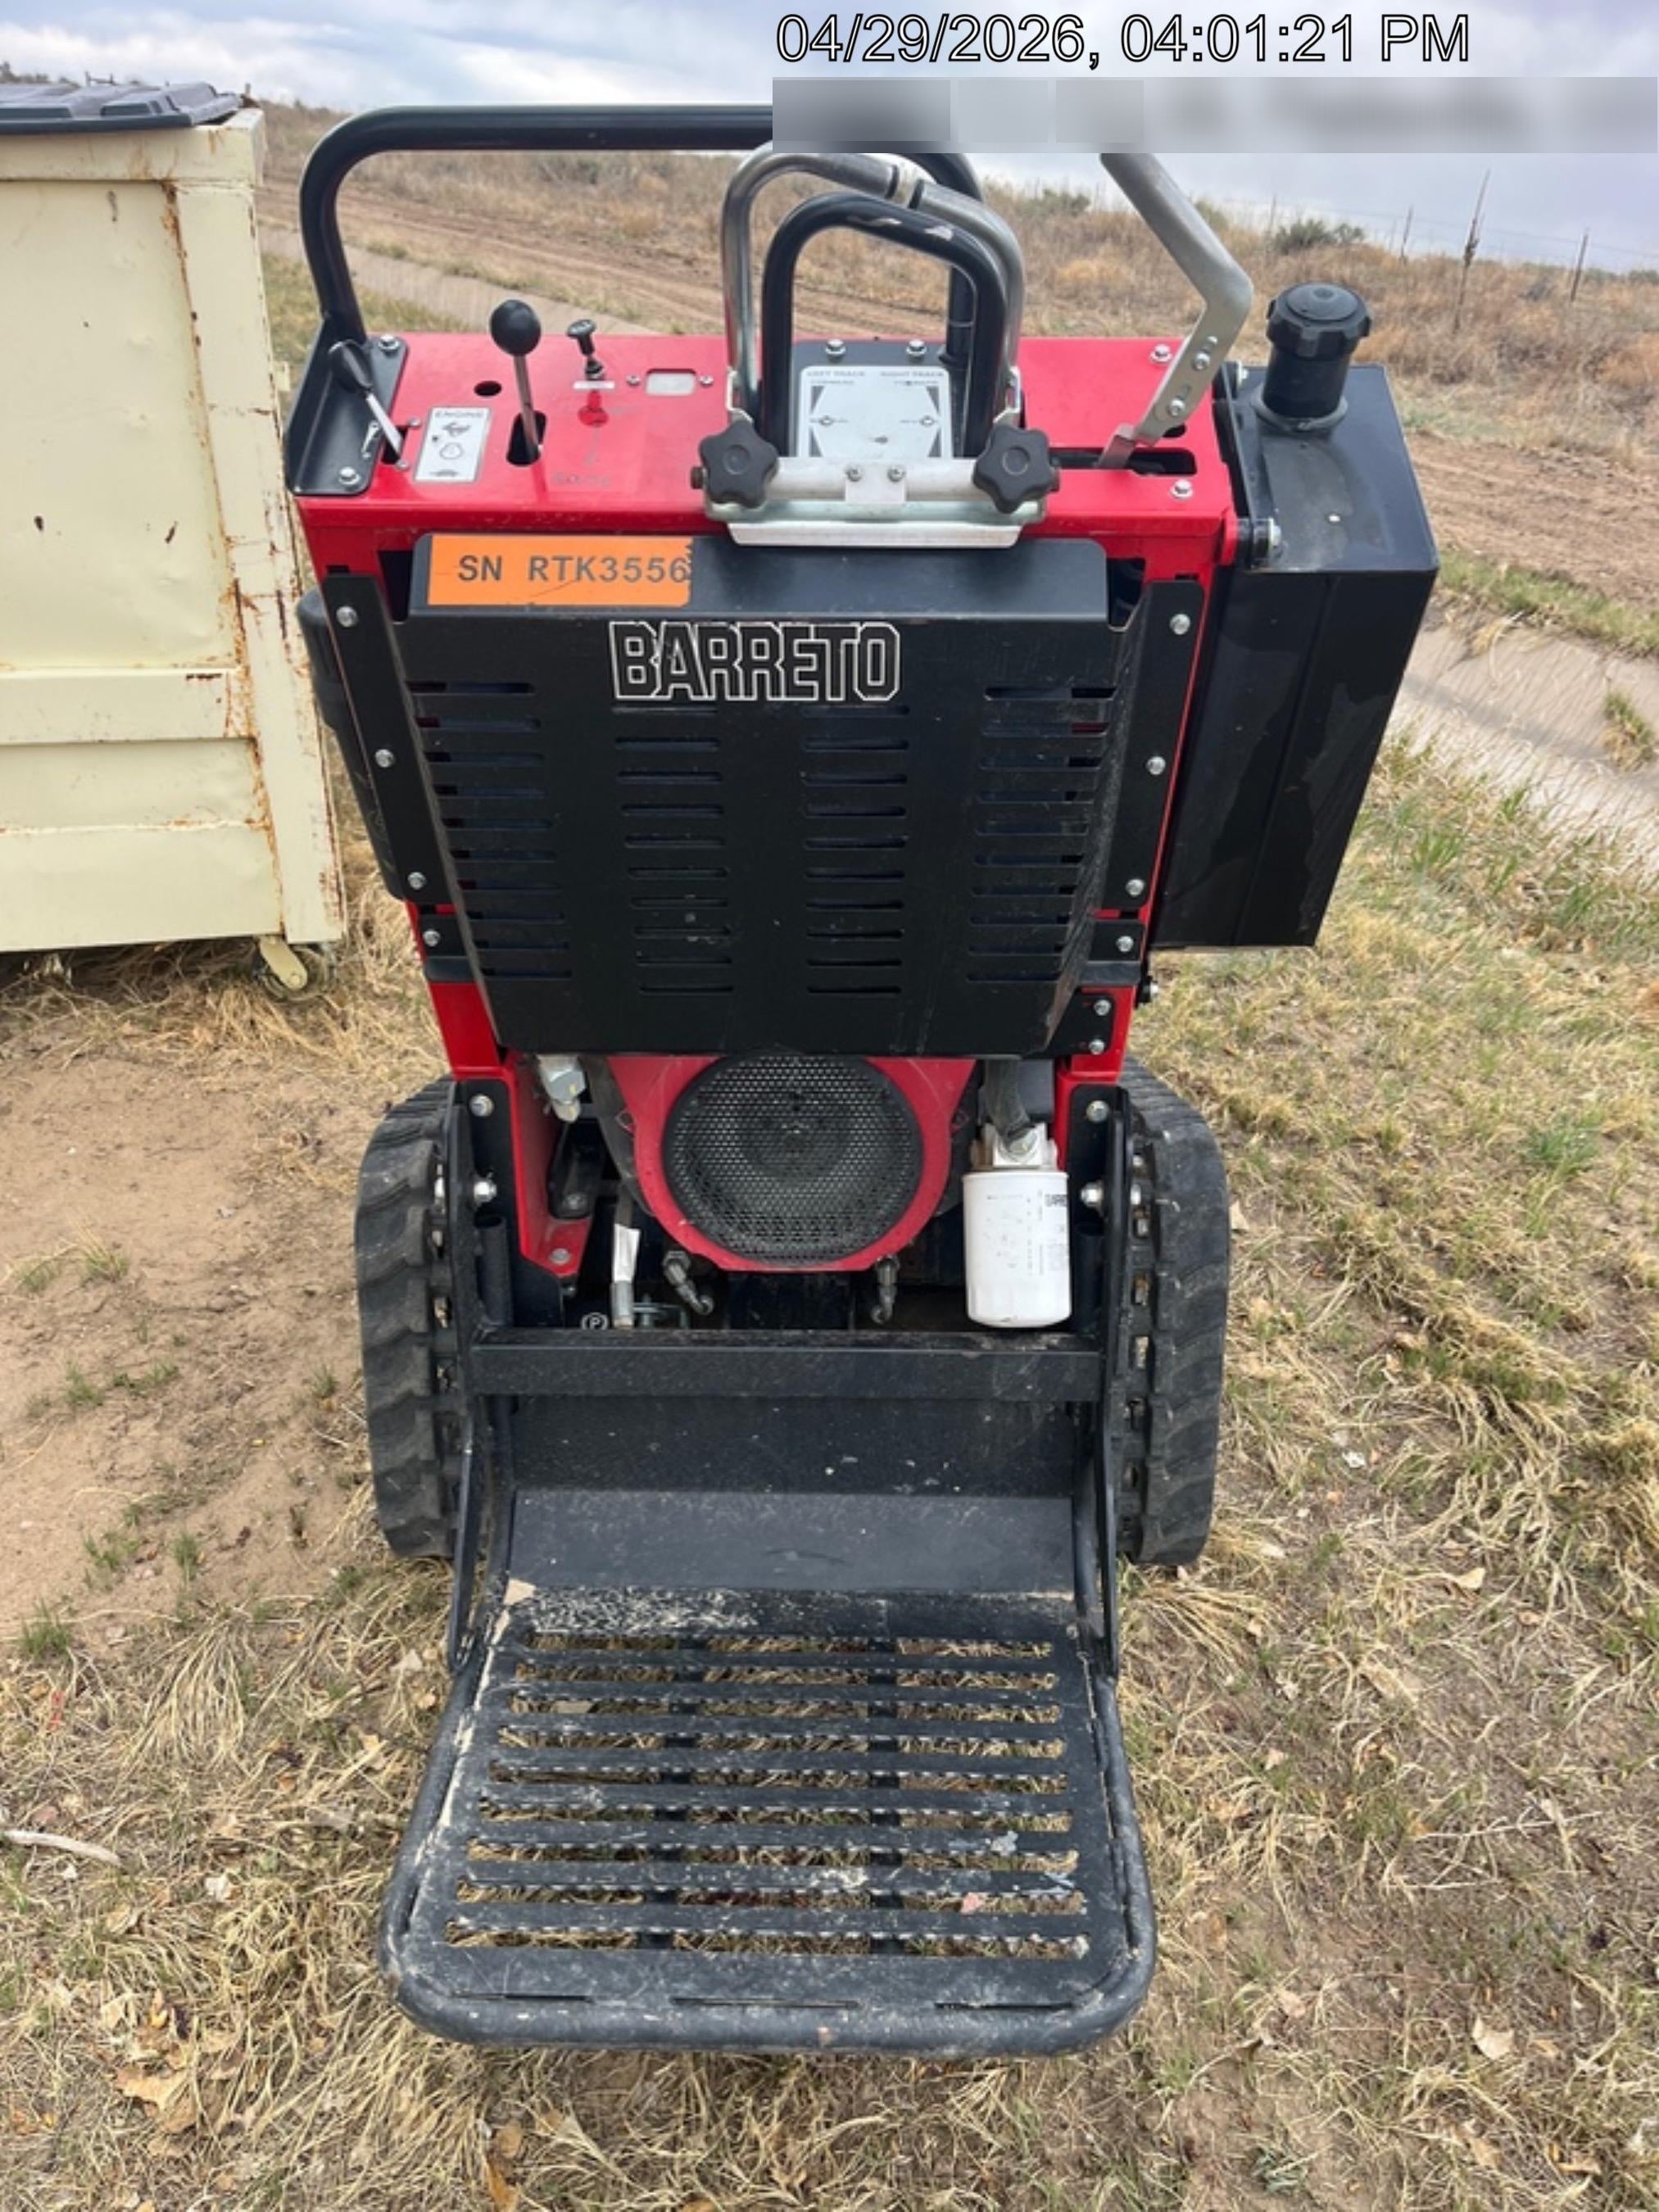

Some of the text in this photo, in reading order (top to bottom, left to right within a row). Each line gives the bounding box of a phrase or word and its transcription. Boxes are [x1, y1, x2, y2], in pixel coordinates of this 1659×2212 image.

[458, 555, 689, 583] SN RTK3556
[609, 621, 900, 702] BARRETO
